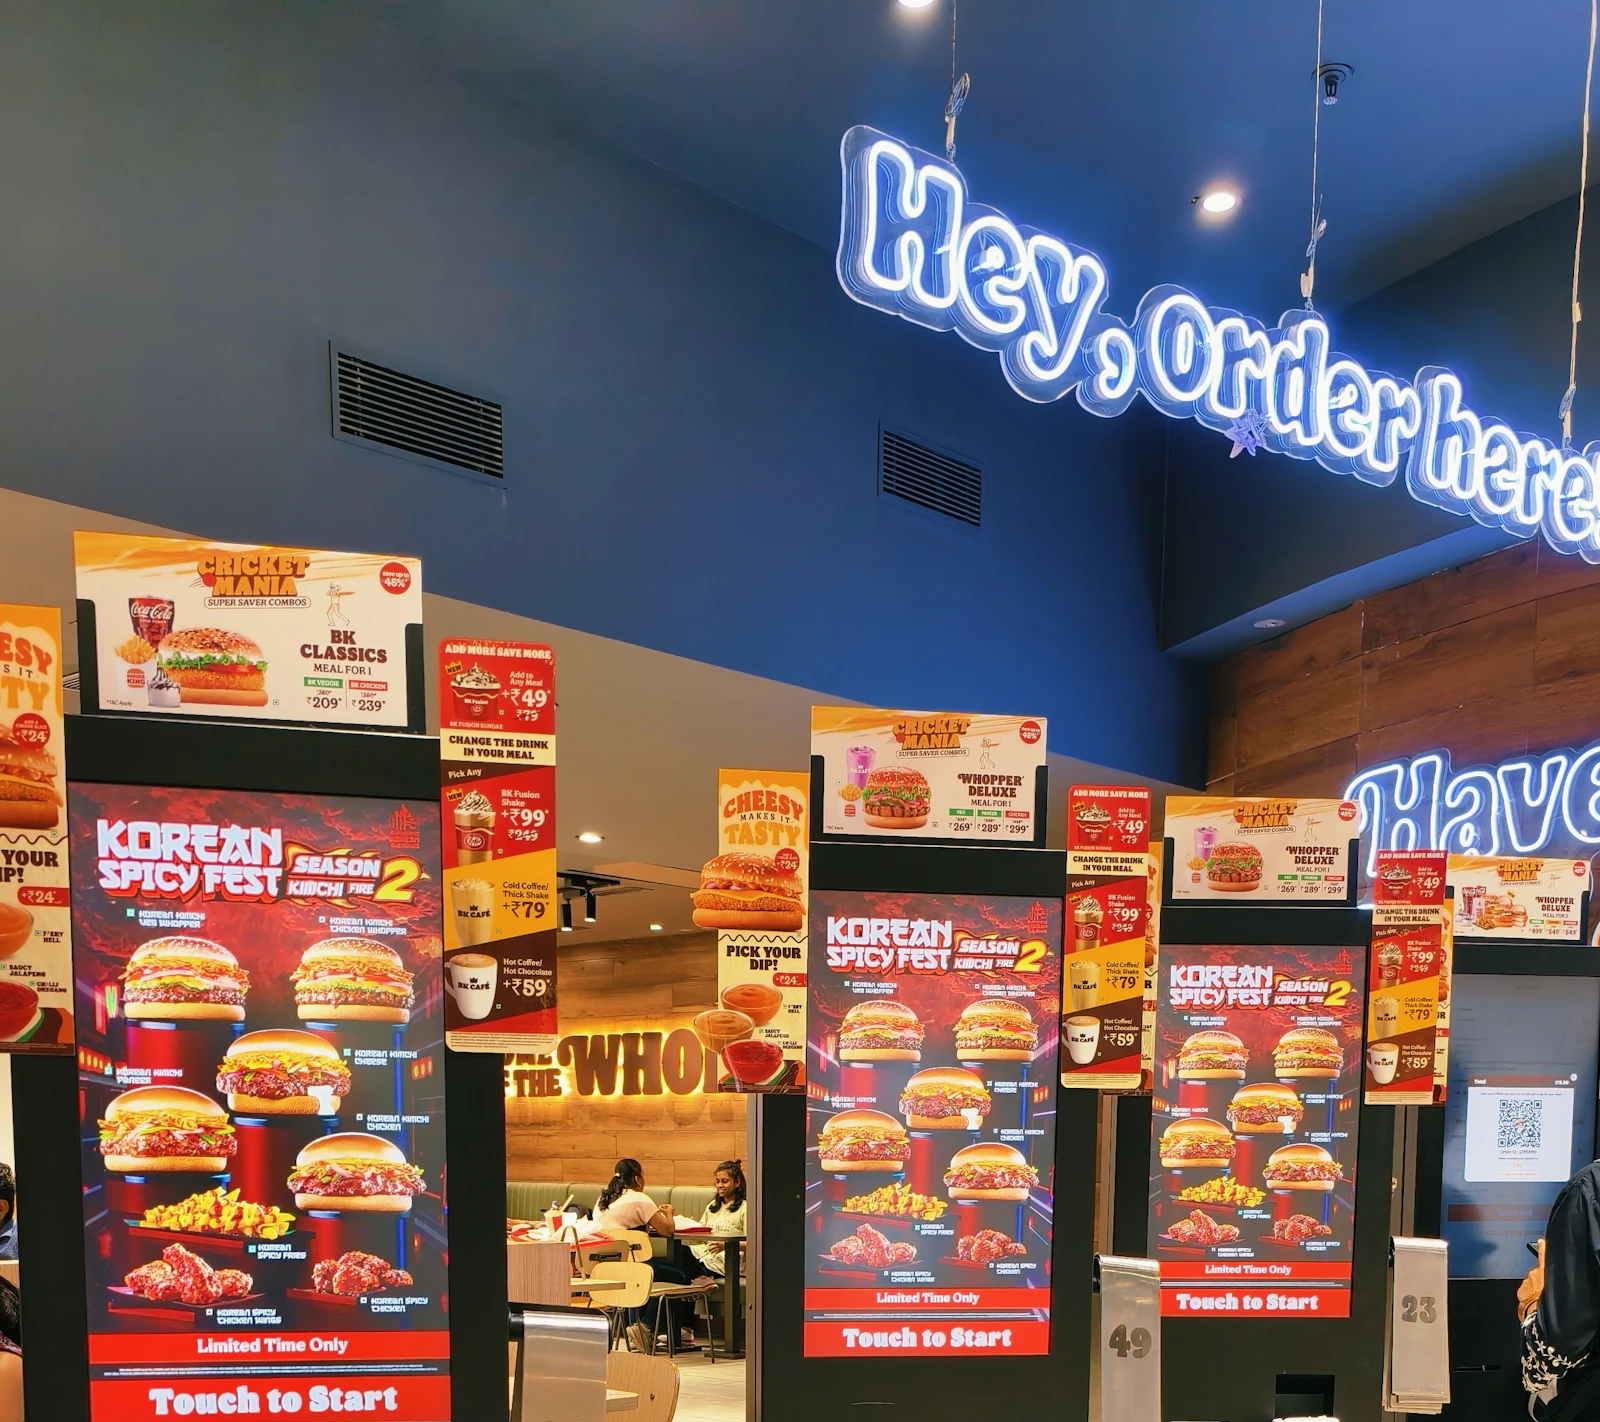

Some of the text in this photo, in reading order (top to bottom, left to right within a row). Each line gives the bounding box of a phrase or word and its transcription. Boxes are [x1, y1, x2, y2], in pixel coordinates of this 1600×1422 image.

[1148, 293, 1420, 472] Order
[1420, 373, 1600, 549] here
[197, 556, 311, 578] CRICKET
[212, 576, 298, 597] MANIA
[208, 598, 307, 607] SUPER SAVER COMBOS
[131, 602, 173, 620] Coca-Cola
[331, 630, 356, 645] BK
[300, 644, 387, 663] CLASSICS
[445, 645, 551, 659] ADD MORE SAVE MORE
[314, 664, 343, 674] MEAL
[346, 666, 366, 675] FOR
[510, 679, 524, 687] Any
[893, 718, 971, 736] CRICKET
[449, 736, 548, 749] CHANGE THE DRINK
[902, 734, 961, 750] MANIA
[464, 748, 535, 760] IN YOUR MEAL
[448, 767, 482, 779] Pick Any
[958, 774, 1022, 786] WHOPPER
[501, 790, 540, 799] BK Fusion
[969, 786, 1016, 798] DELUXE
[502, 799, 525, 807] Shake
[724, 790, 803, 821] CHEESY
[1233, 802, 1298, 816] CRICKET
[740, 812, 791, 824] MAKES IT
[1240, 814, 1289, 828] MANIA
[724, 821, 801, 846] TASTY
[97, 819, 283, 867] KOREAN
[1286, 846, 1340, 856] WHOPPER
[1, 850, 59, 867] YOUR
[1294, 855, 1335, 865] DELUXE
[1496, 861, 1544, 872] CRICKET
[99, 861, 283, 898] SPICY FEST
[294, 856, 421, 901] SEASON 2
[1502, 870, 1538, 881] MANIA
[288, 880, 374, 897] KIMCHI FIRE
[503, 882, 549, 891] Cold Coffee/
[503, 890, 549, 900] Thick Shake
[1535, 896, 1574, 905] WHOPPER
[1542, 904, 1571, 912] DELUXE
[826, 916, 952, 948] KOREAN
[726, 945, 801, 959] PICK YOUR
[827, 946, 952, 970] SPICY FEST
[959, 940, 1048, 972] SEASON 2
[517, 959, 543, 967] Coffee/
[750, 959, 778, 971] DIP!
[954, 958, 1014, 970] KIMCHI FIRE
[503, 967, 553, 976] Hot Chocolate
[1170, 965, 1274, 988] KOREAN
[1170, 988, 1272, 1006] SPICY FEST
[1278, 980, 1352, 1006] SEASON 2
[1274, 996, 1324, 1005] KIMCHI FIRE
[513, 1068, 562, 1097] THE
[1205, 1265, 1291, 1276] Limited Time Only
[877, 1293, 980, 1305] Limited Time Only
[1176, 1293, 1318, 1310] Touch to Start
[1401, 1295, 1437, 1324] 23
[843, 1327, 1012, 1348] Touch to Start
[1109, 1324, 1152, 1359] 49
[197, 1337, 348, 1355] Limited Time Only
[149, 1385, 398, 1416] Touch to Start
